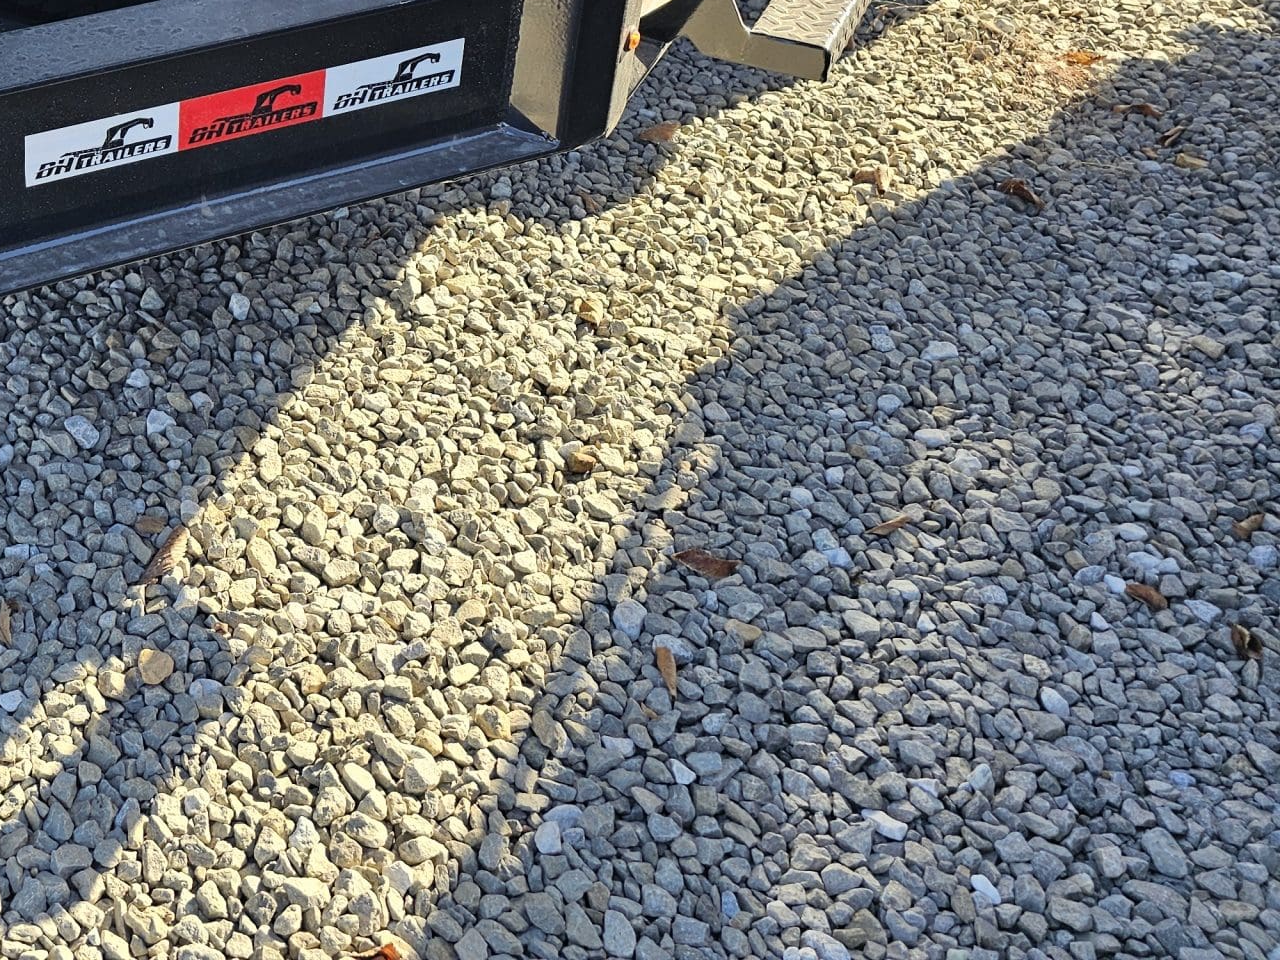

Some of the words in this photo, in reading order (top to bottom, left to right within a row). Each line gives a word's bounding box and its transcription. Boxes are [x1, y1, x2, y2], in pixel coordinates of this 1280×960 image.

[333, 87, 368, 110] DH
[373, 73, 450, 100] TRAILERS
[189, 121, 224, 145] DH
[230, 105, 313, 134] TRAILERS
[36, 155, 71, 179] DH
[78, 139, 167, 169] TRAILERS
